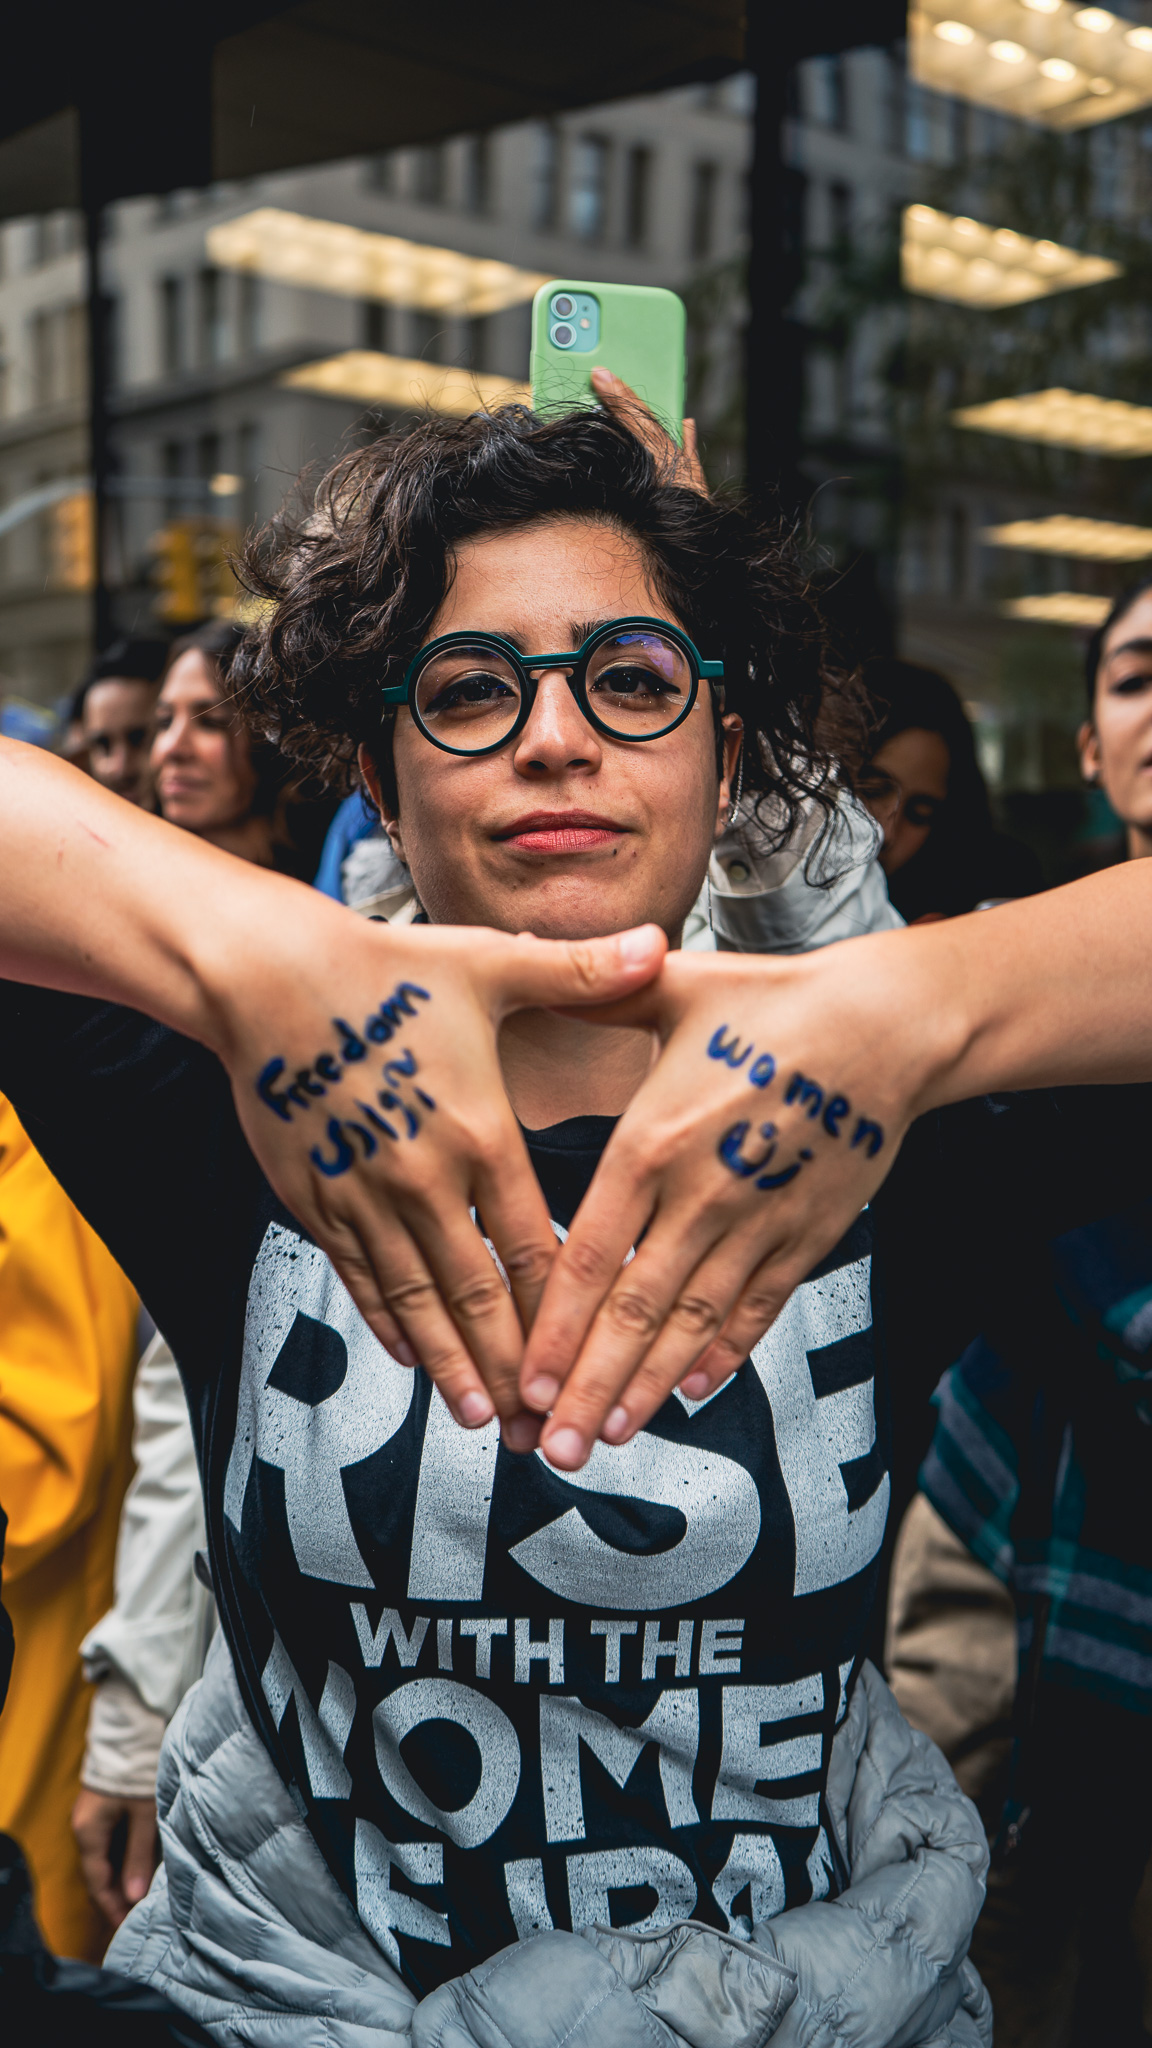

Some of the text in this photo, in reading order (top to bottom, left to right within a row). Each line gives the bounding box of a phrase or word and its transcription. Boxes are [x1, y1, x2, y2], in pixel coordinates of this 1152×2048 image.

[256, 981, 432, 1122] Freedom
[223, 1202, 890, 1611] RISE
[349, 1601, 746, 1685] WITH THE
[260, 1628, 855, 1849] WOME
